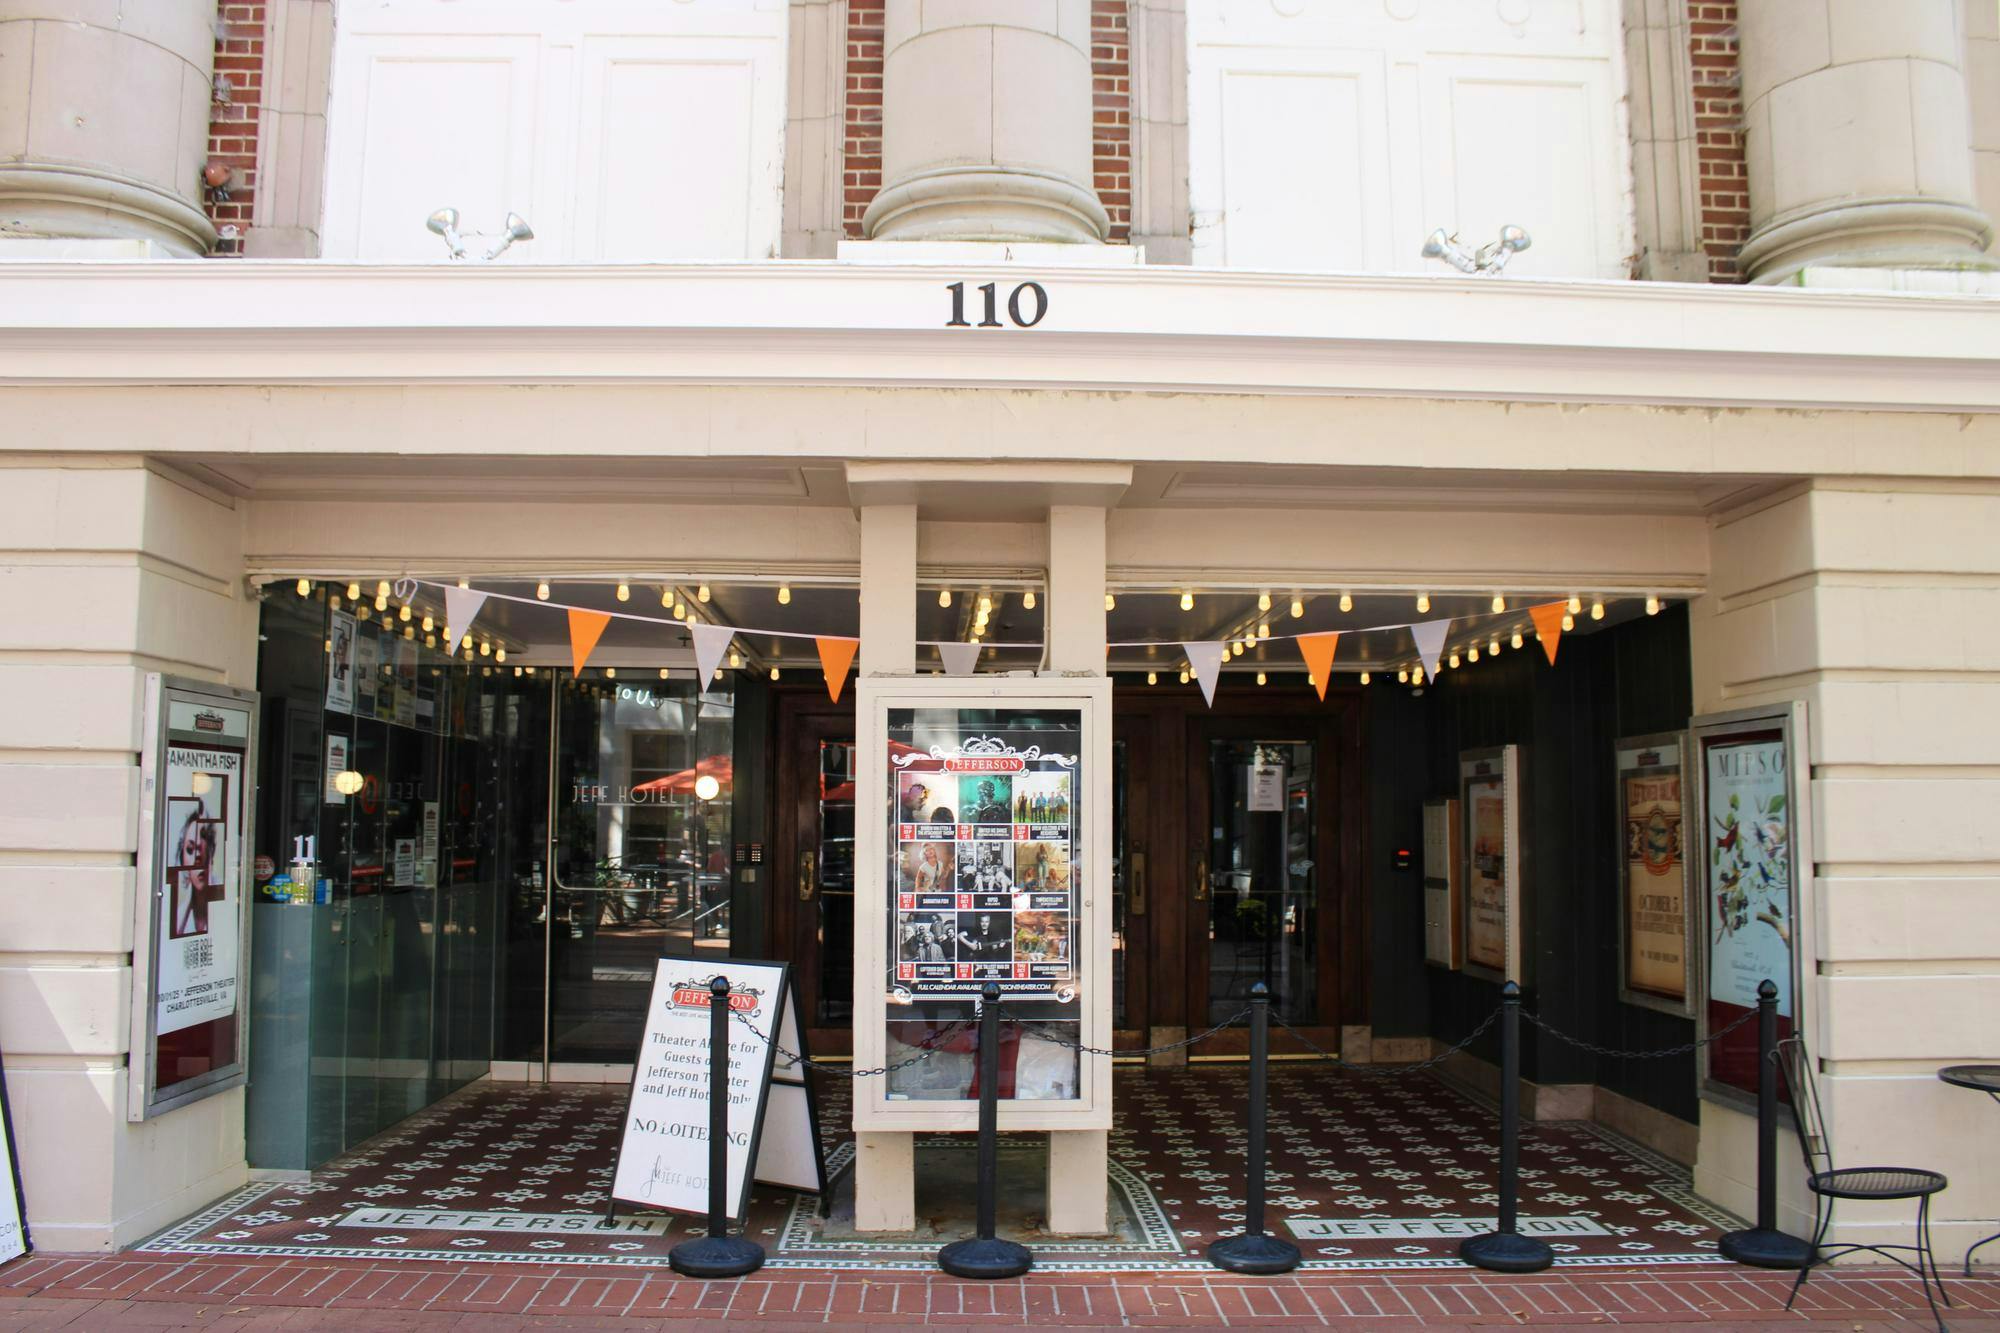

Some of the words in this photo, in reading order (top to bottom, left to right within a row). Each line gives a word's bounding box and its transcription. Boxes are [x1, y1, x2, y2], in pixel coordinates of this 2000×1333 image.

[945, 281, 1048, 328] 110
[168, 750, 218, 769] AMANTHA
[219, 754, 237, 770] FISH
[950, 759, 1019, 770] JEFFERSON
[572, 785, 608, 803] JEFF
[618, 785, 678, 804] HOTEL
[677, 992, 753, 1008] JEFFON
[652, 1032, 697, 1048] Theater
[740, 1040, 758, 1054] for
[664, 1050, 702, 1065] Guests
[648, 1066, 700, 1082] Jefferson
[642, 1083, 664, 1094] and
[666, 1085, 689, 1098] Jeff
[632, 1117, 658, 1134] NO
[660, 1121, 748, 1146] LOITENG
[360, 1212, 654, 1232] JEFFERSON
[1307, 1220, 1591, 1235] JEFFERON
